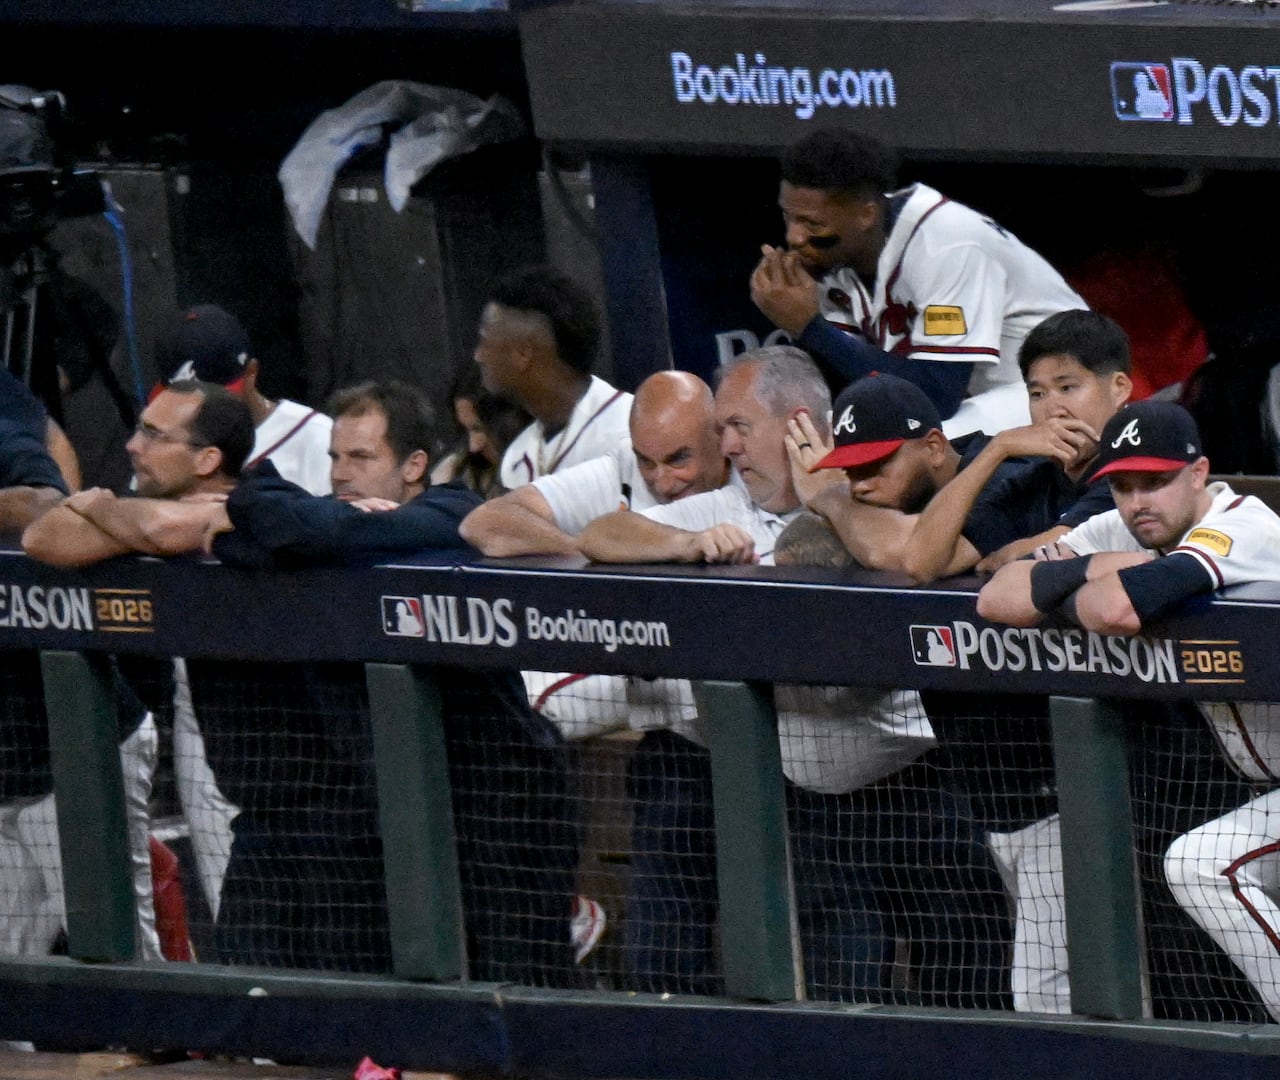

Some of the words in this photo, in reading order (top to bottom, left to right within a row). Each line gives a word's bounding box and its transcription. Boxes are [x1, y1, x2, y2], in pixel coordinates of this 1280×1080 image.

[671, 52, 897, 119] Booking.com
[97, 597, 152, 622] 2026
[424, 594, 518, 647] NLDS
[526, 607, 670, 652] Booking.com
[953, 620, 1180, 683] POSTSEASON
[1182, 649, 1245, 674] 2026
